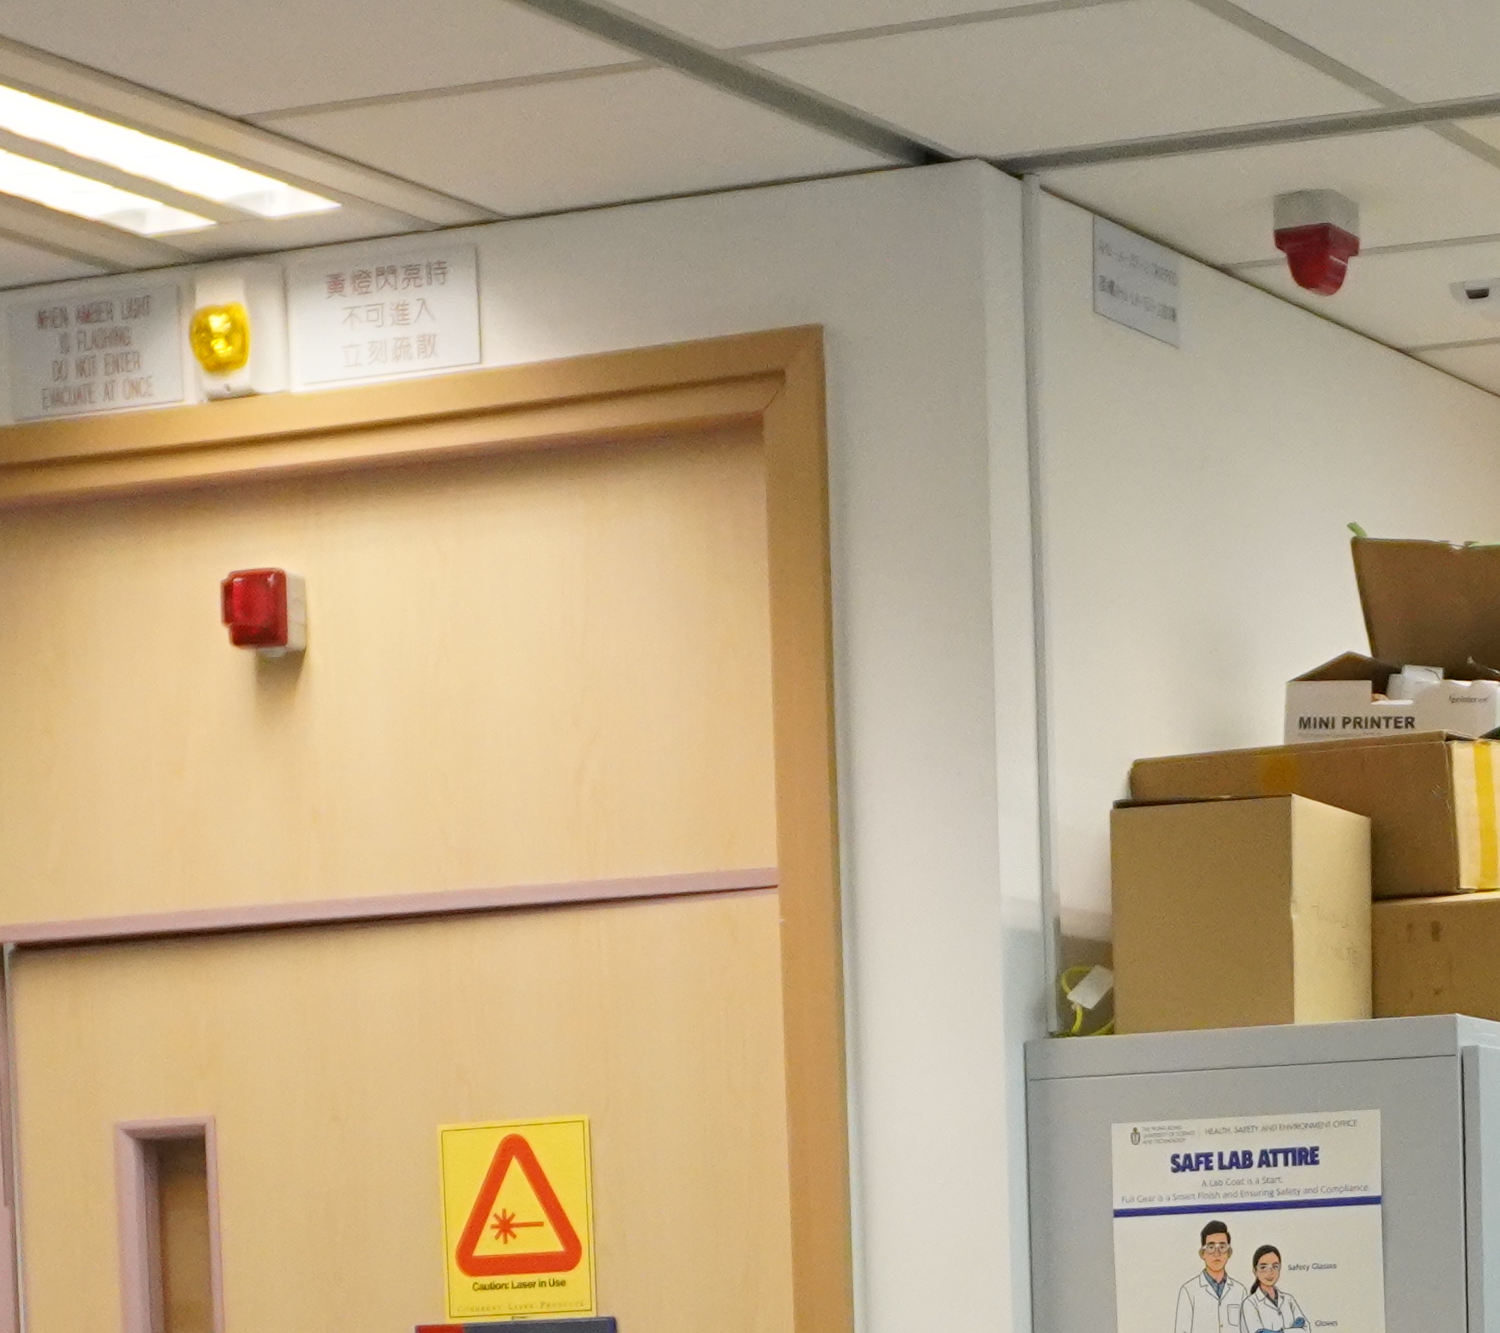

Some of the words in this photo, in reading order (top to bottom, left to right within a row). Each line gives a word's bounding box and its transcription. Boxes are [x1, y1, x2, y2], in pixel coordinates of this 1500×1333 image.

[37, 306, 69, 330] WHEN
[75, 301, 114, 324] AMBER
[120, 295, 152, 320] LIGHT
[341, 298, 436, 330] 不可進入
[76, 326, 132, 351] FLASHING
[52, 360, 69, 382] DO
[75, 354, 97, 378] NOT
[104, 351, 141, 376] ENTER
[42, 383, 96, 410] EVACUATE
[103, 380, 116, 402] AT
[122, 376, 155, 400] ONCE
[1298, 716, 1336, 729] MINI
[1341, 716, 1416, 729] PRINTER
[1234, 1125, 1258, 1133] SAFETY
[1261, 1124, 1277, 1132] AND
[1279, 1121, 1330, 1130] ENVIRONMENT
[1333, 1119, 1357, 1128] OFFICE
[1170, 1151, 1214, 1173] SAFE
[1217, 1149, 1253, 1171] LAB
[1257, 1146, 1319, 1168] ATTIRE
[1210, 1179, 1223, 1187] Lab
[1226, 1178, 1244, 1186] Coat
[1121, 1196, 1135, 1204] Full
[1137, 1195, 1155, 1203] Gear
[1198, 1191, 1220, 1200] Finish
[1223, 1190, 1238, 1198] and
[1240, 1189, 1274, 1198] Ensuring
[1276, 1187, 1300, 1196] Safety
[1303, 1185, 1318, 1194] and
[1287, 1263, 1310, 1271] Safety
[472, 1281, 509, 1292] Caution:
[511, 1279, 536, 1290] Laser
[538, 1278, 546, 1288] in
[548, 1278, 567, 1288] Use
